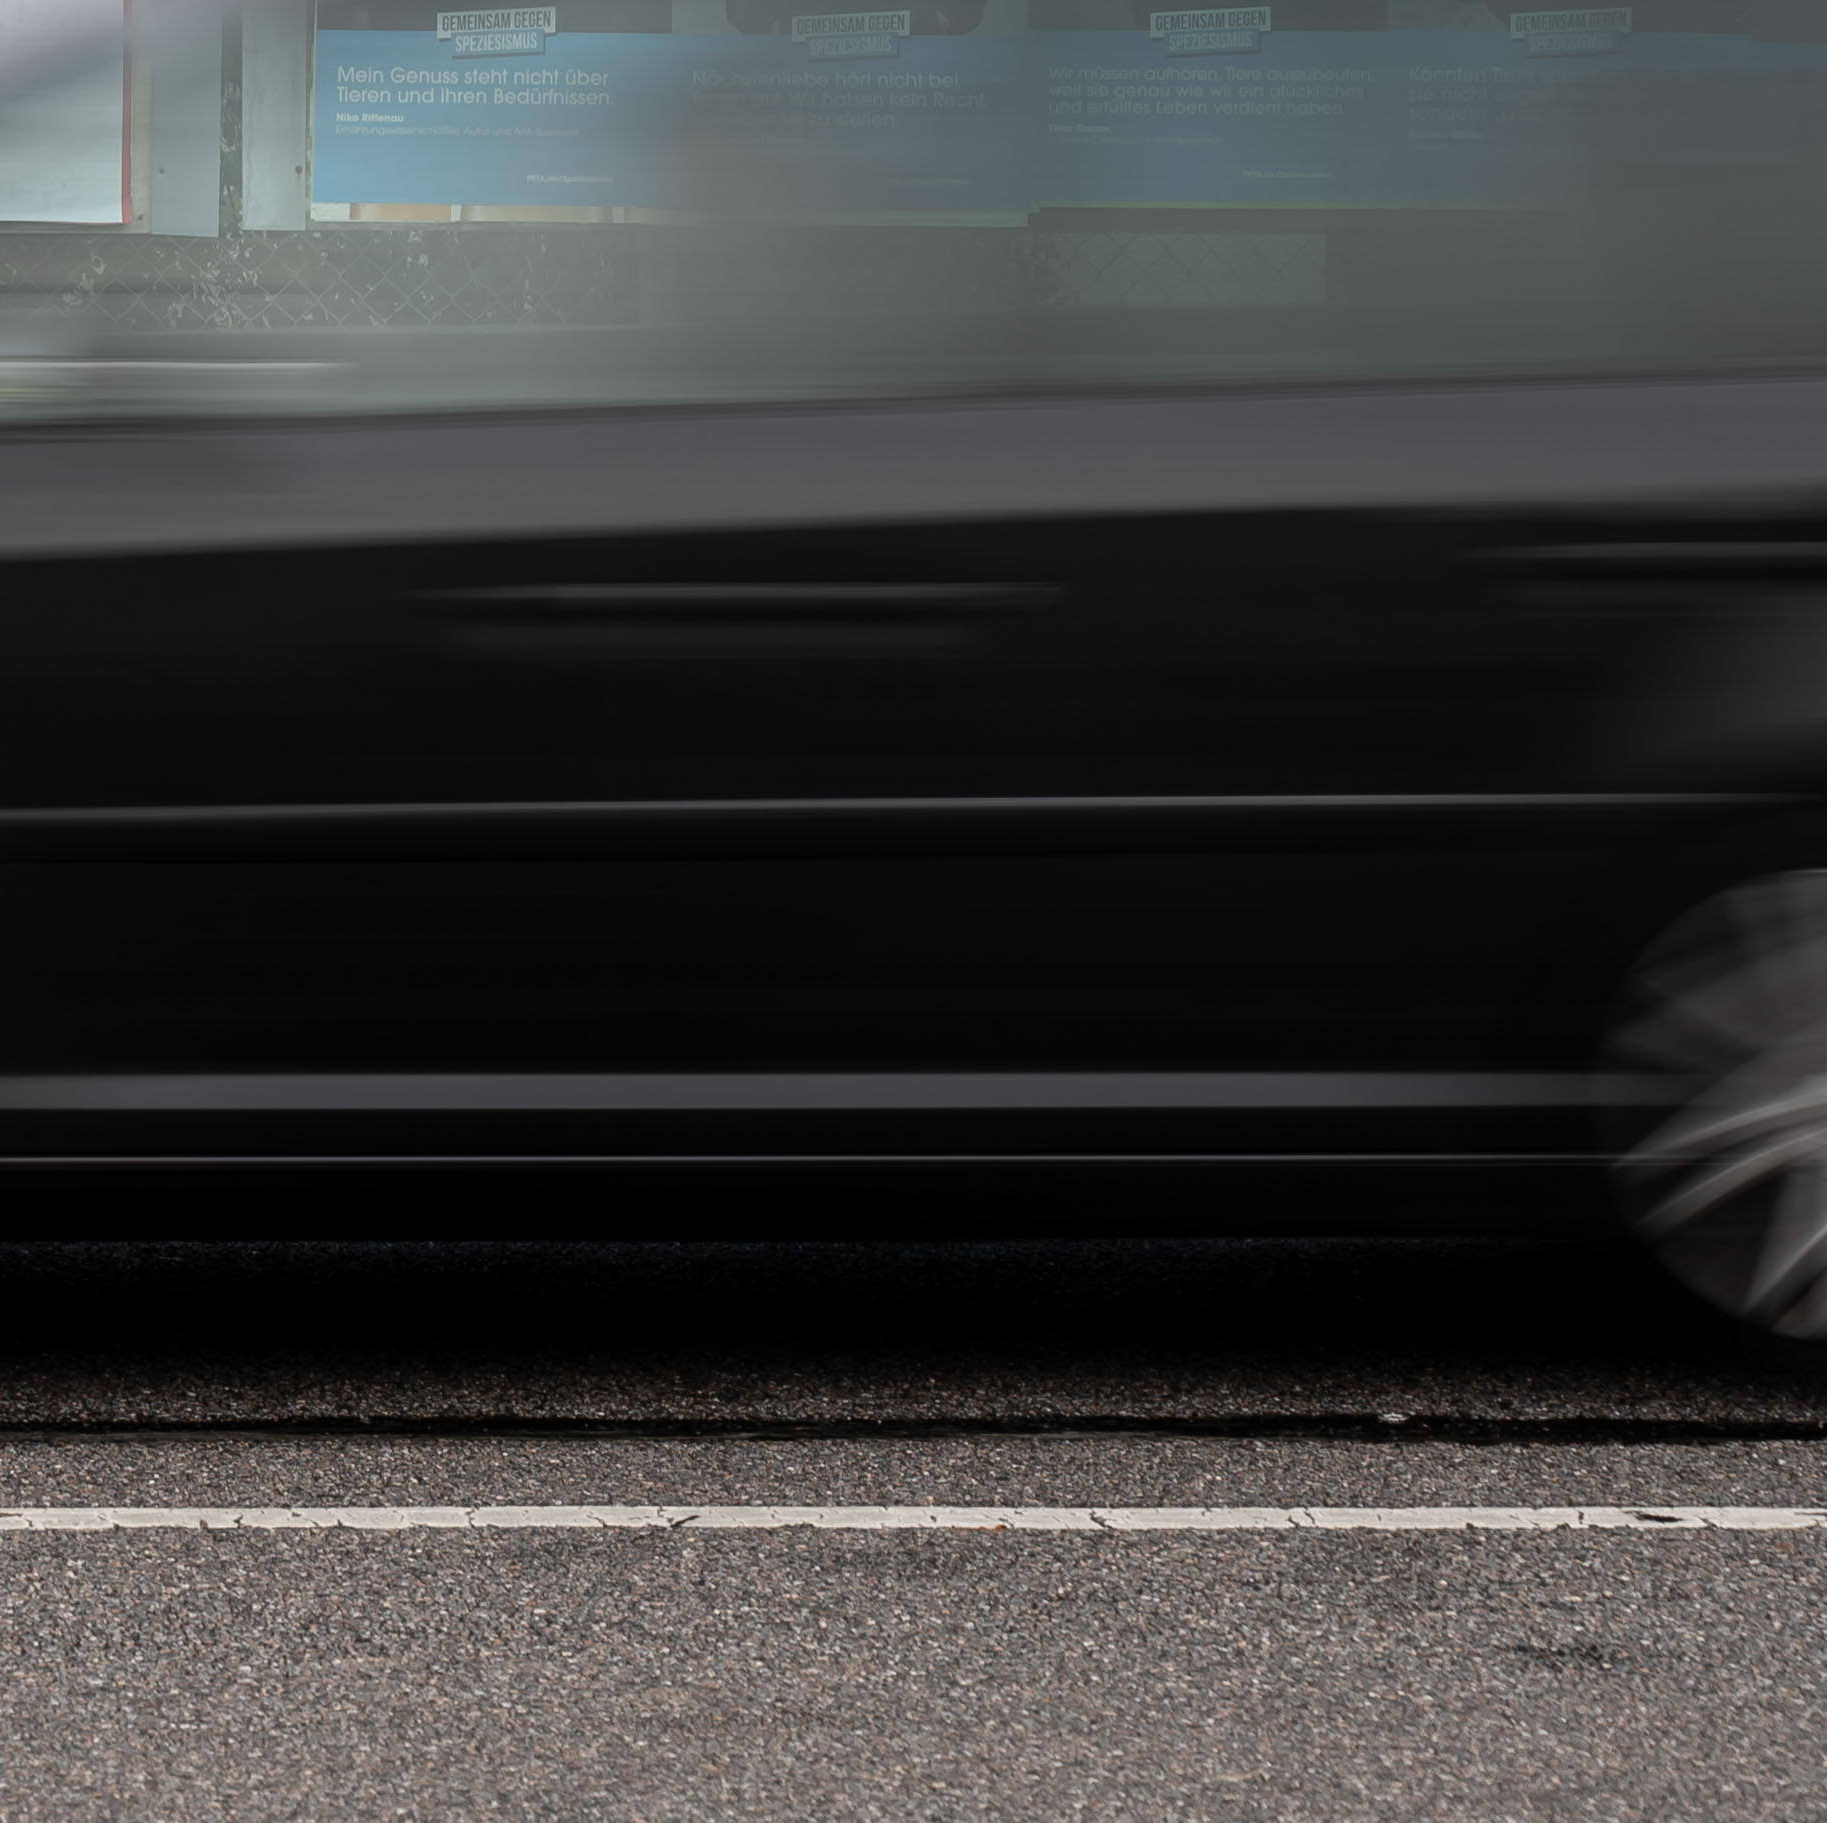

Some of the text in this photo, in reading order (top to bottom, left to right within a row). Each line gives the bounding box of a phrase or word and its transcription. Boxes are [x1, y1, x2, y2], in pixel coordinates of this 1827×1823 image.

[442, 10, 551, 32] GEMEINSAM GEGEN
[454, 32, 538, 53] SPEZIESISMUS
[337, 66, 609, 87] Mein Genuss steht nicht über
